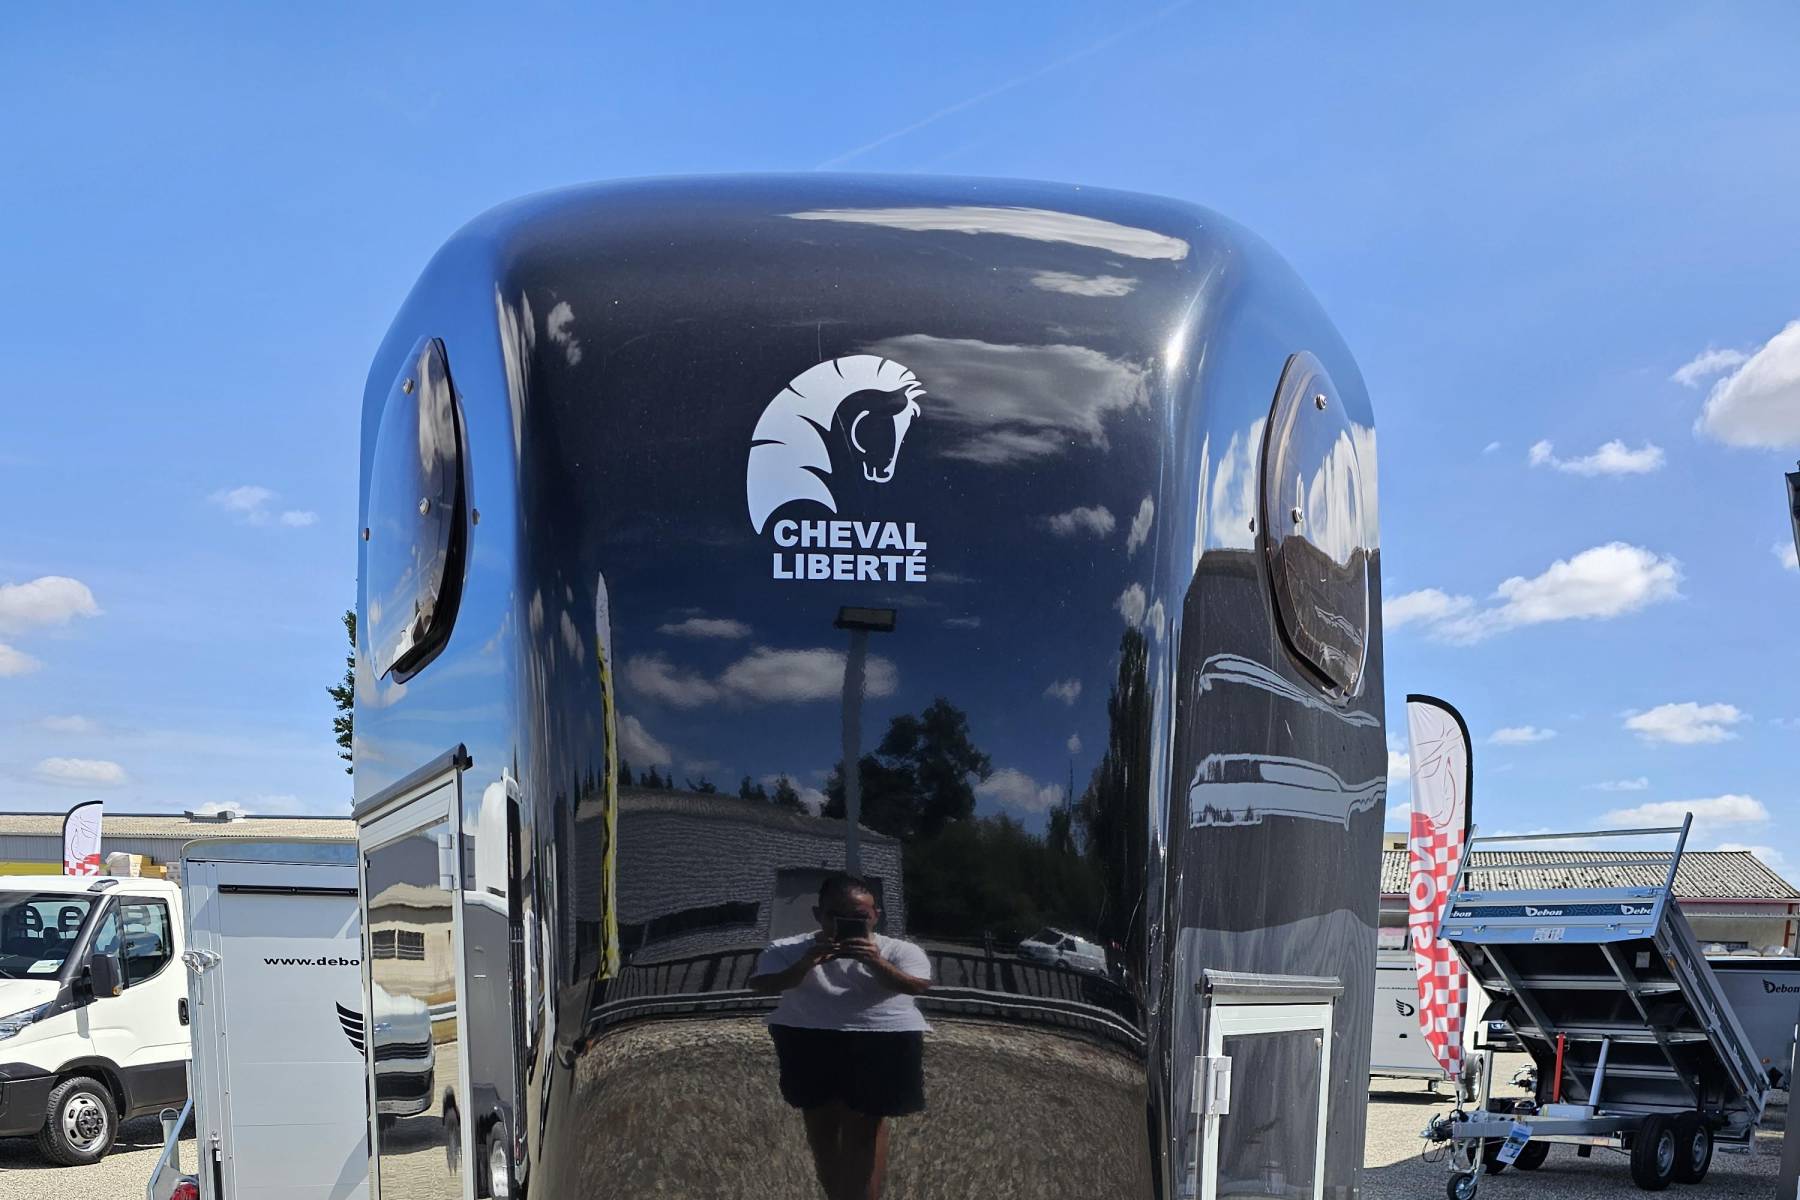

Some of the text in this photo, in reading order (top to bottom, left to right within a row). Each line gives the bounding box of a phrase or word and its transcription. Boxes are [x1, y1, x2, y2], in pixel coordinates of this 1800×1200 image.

[773, 519, 927, 550] CHEVAL
[773, 550, 927, 582] LIBERTÉ
[1525, 906, 1563, 917] Debon
[1762, 979, 1800, 993] Debon
